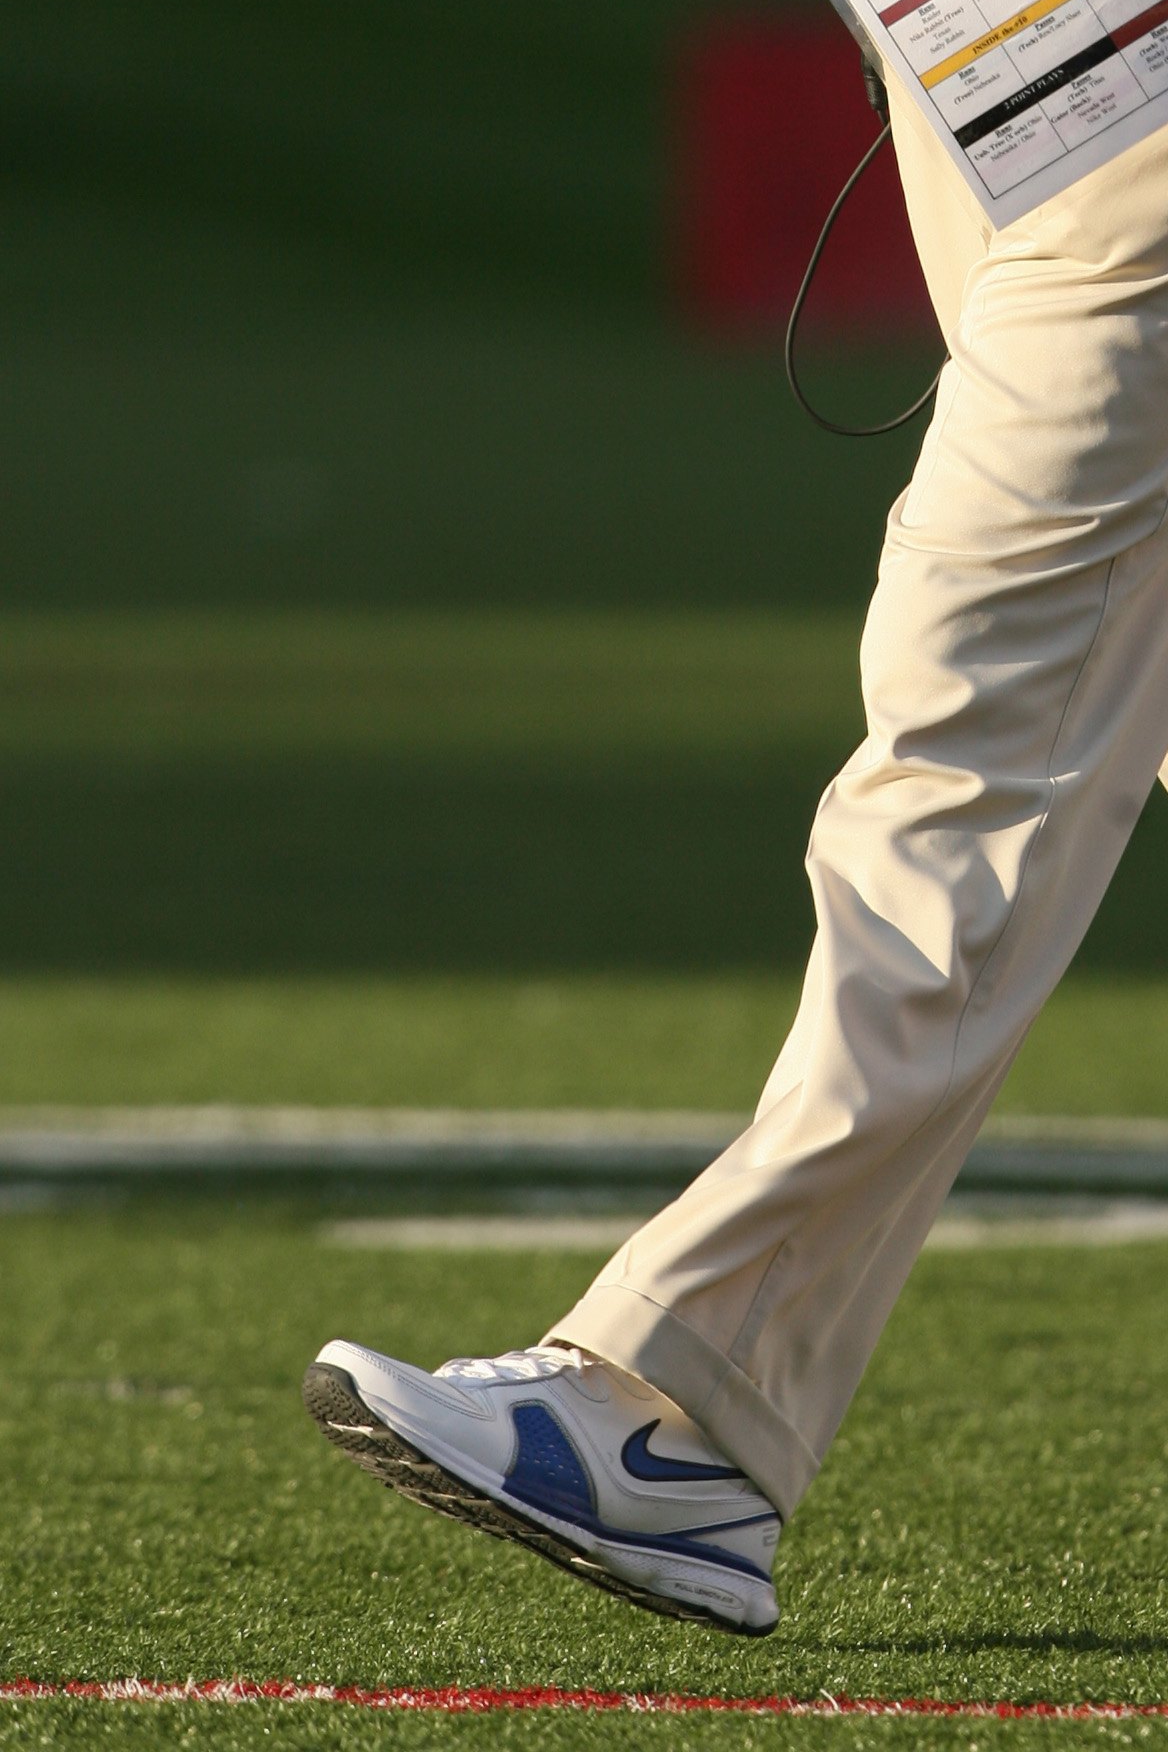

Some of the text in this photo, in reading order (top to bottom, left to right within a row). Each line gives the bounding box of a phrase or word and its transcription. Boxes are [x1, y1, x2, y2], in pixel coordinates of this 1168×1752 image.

[971, 32, 1001, 54] INSIDE
[1009, 85, 1036, 105] POINT
[1036, 67, 1064, 88] PLAYS
